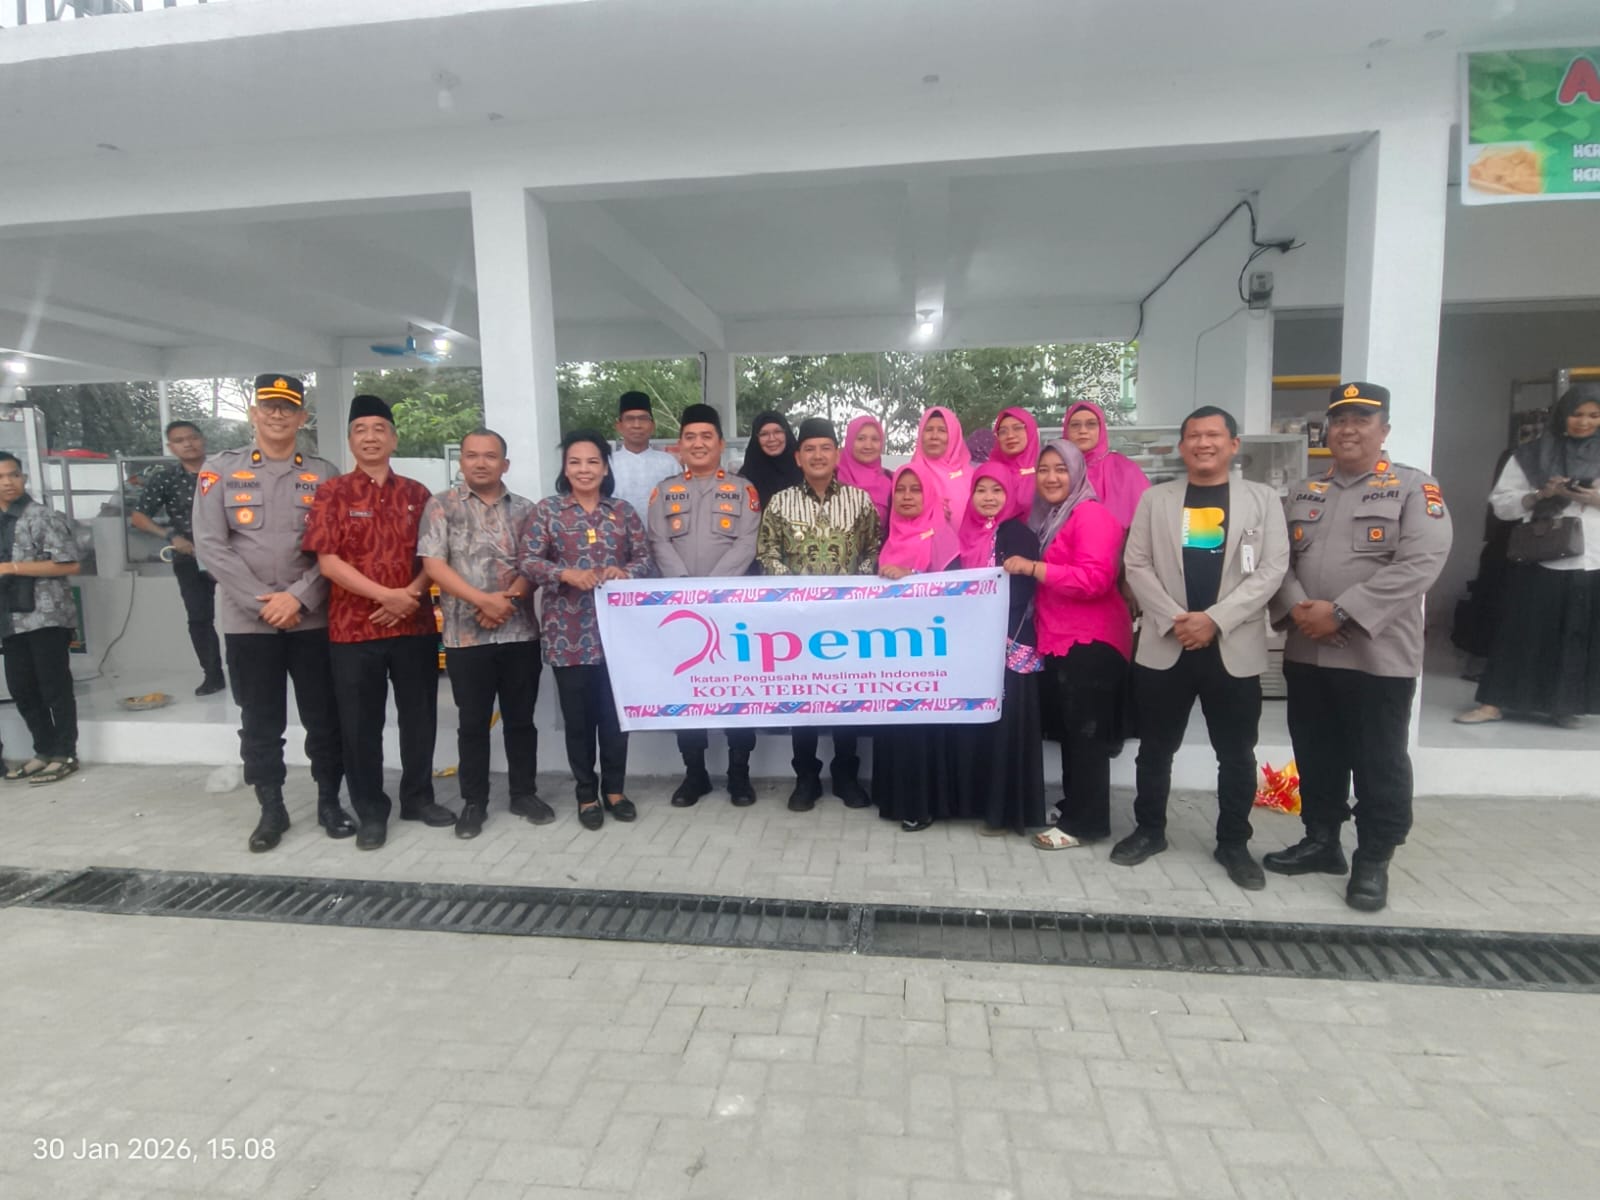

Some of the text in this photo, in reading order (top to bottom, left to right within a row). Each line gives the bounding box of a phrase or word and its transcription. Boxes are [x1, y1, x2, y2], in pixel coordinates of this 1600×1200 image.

[665, 493, 690, 501] RUDI
[715, 492, 740, 501] POLRI
[1362, 490, 1400, 503] POLRI
[730, 616, 948, 673] ipemi
[690, 669, 948, 683] Ikatan Pengusaha Muslimah Indonesia
[692, 680, 940, 698] KOTA TEBING TINGGI
